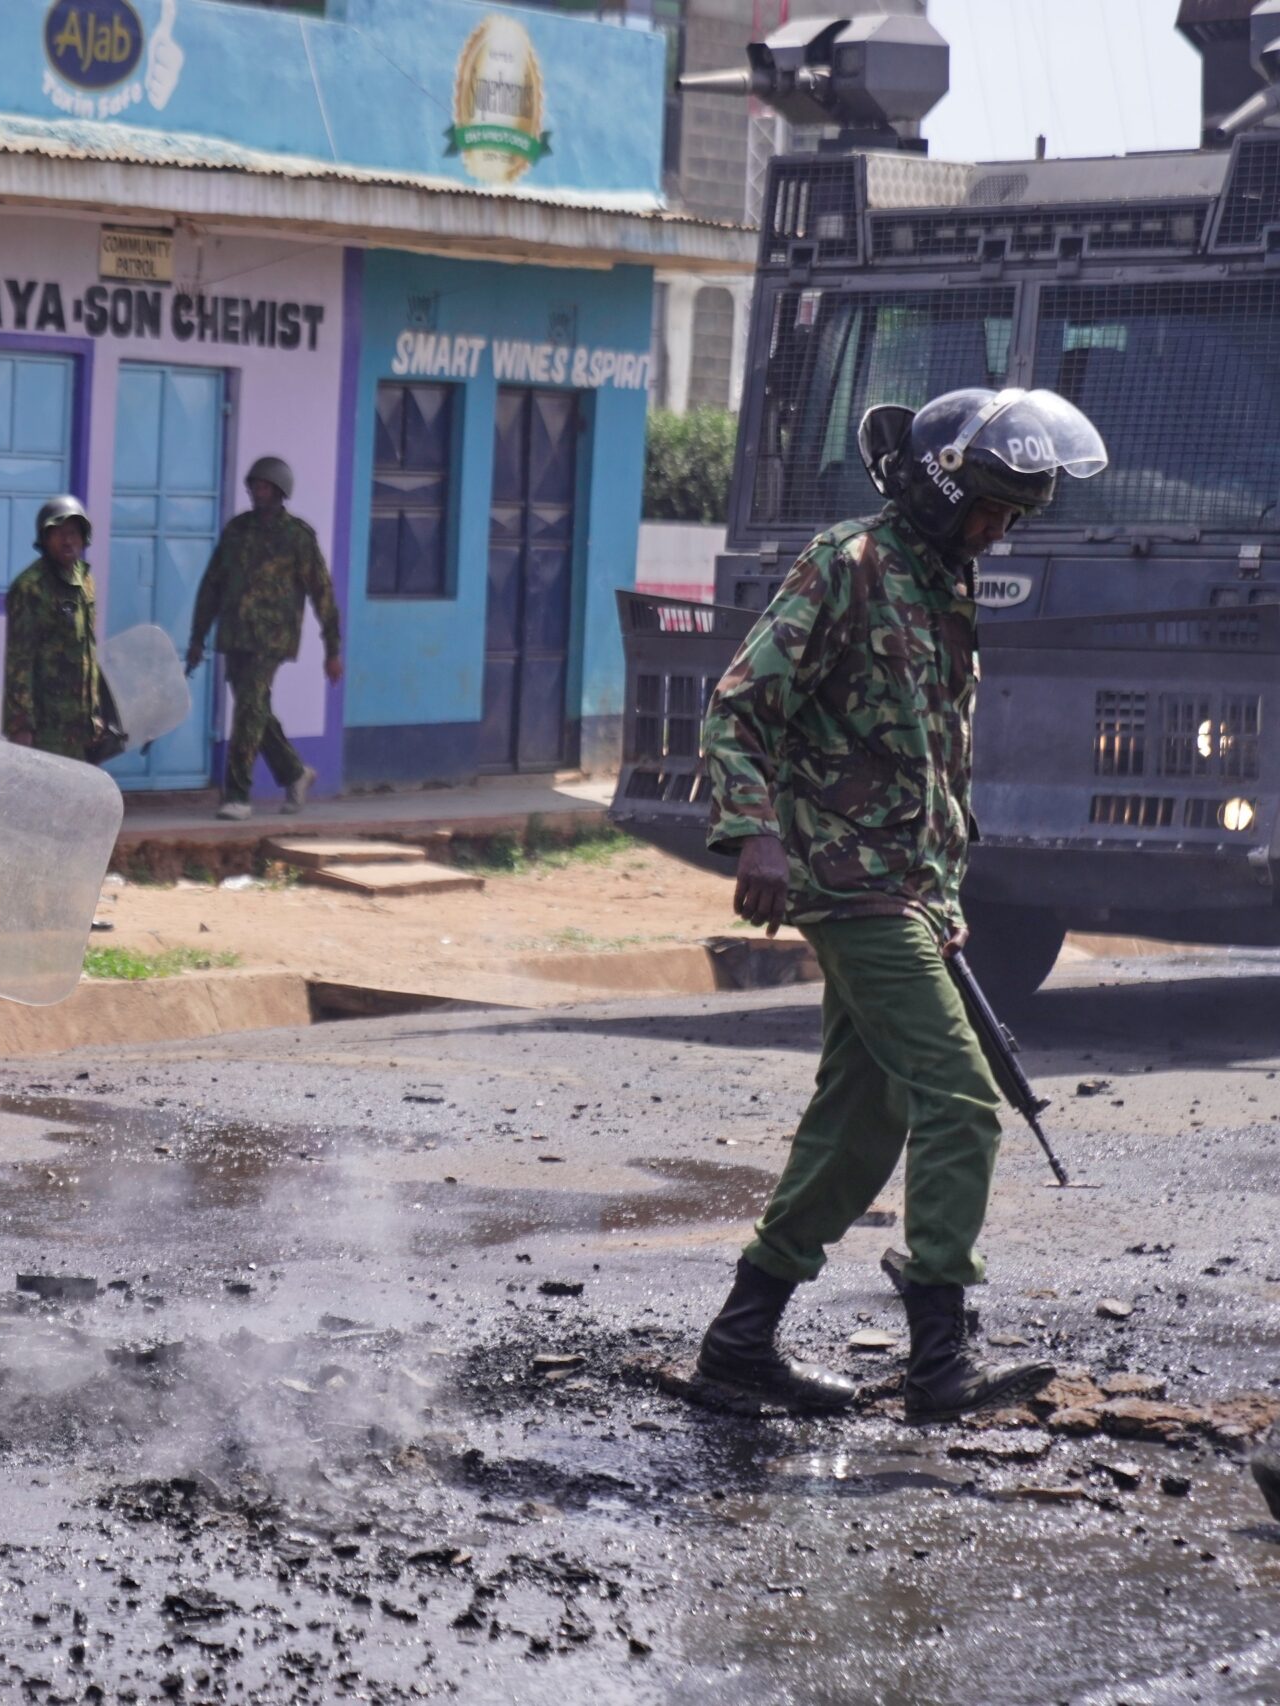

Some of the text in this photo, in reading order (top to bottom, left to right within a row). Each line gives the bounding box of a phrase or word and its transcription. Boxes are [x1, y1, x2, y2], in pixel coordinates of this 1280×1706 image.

[102, 234, 173, 259] COMMUNITY
[115, 256, 158, 278] PATROL
[170, 292, 325, 351] CHEMIST
[391, 329, 486, 379] SMART
[492, 340, 568, 385] WINES
[920, 450, 964, 505] POLICE
